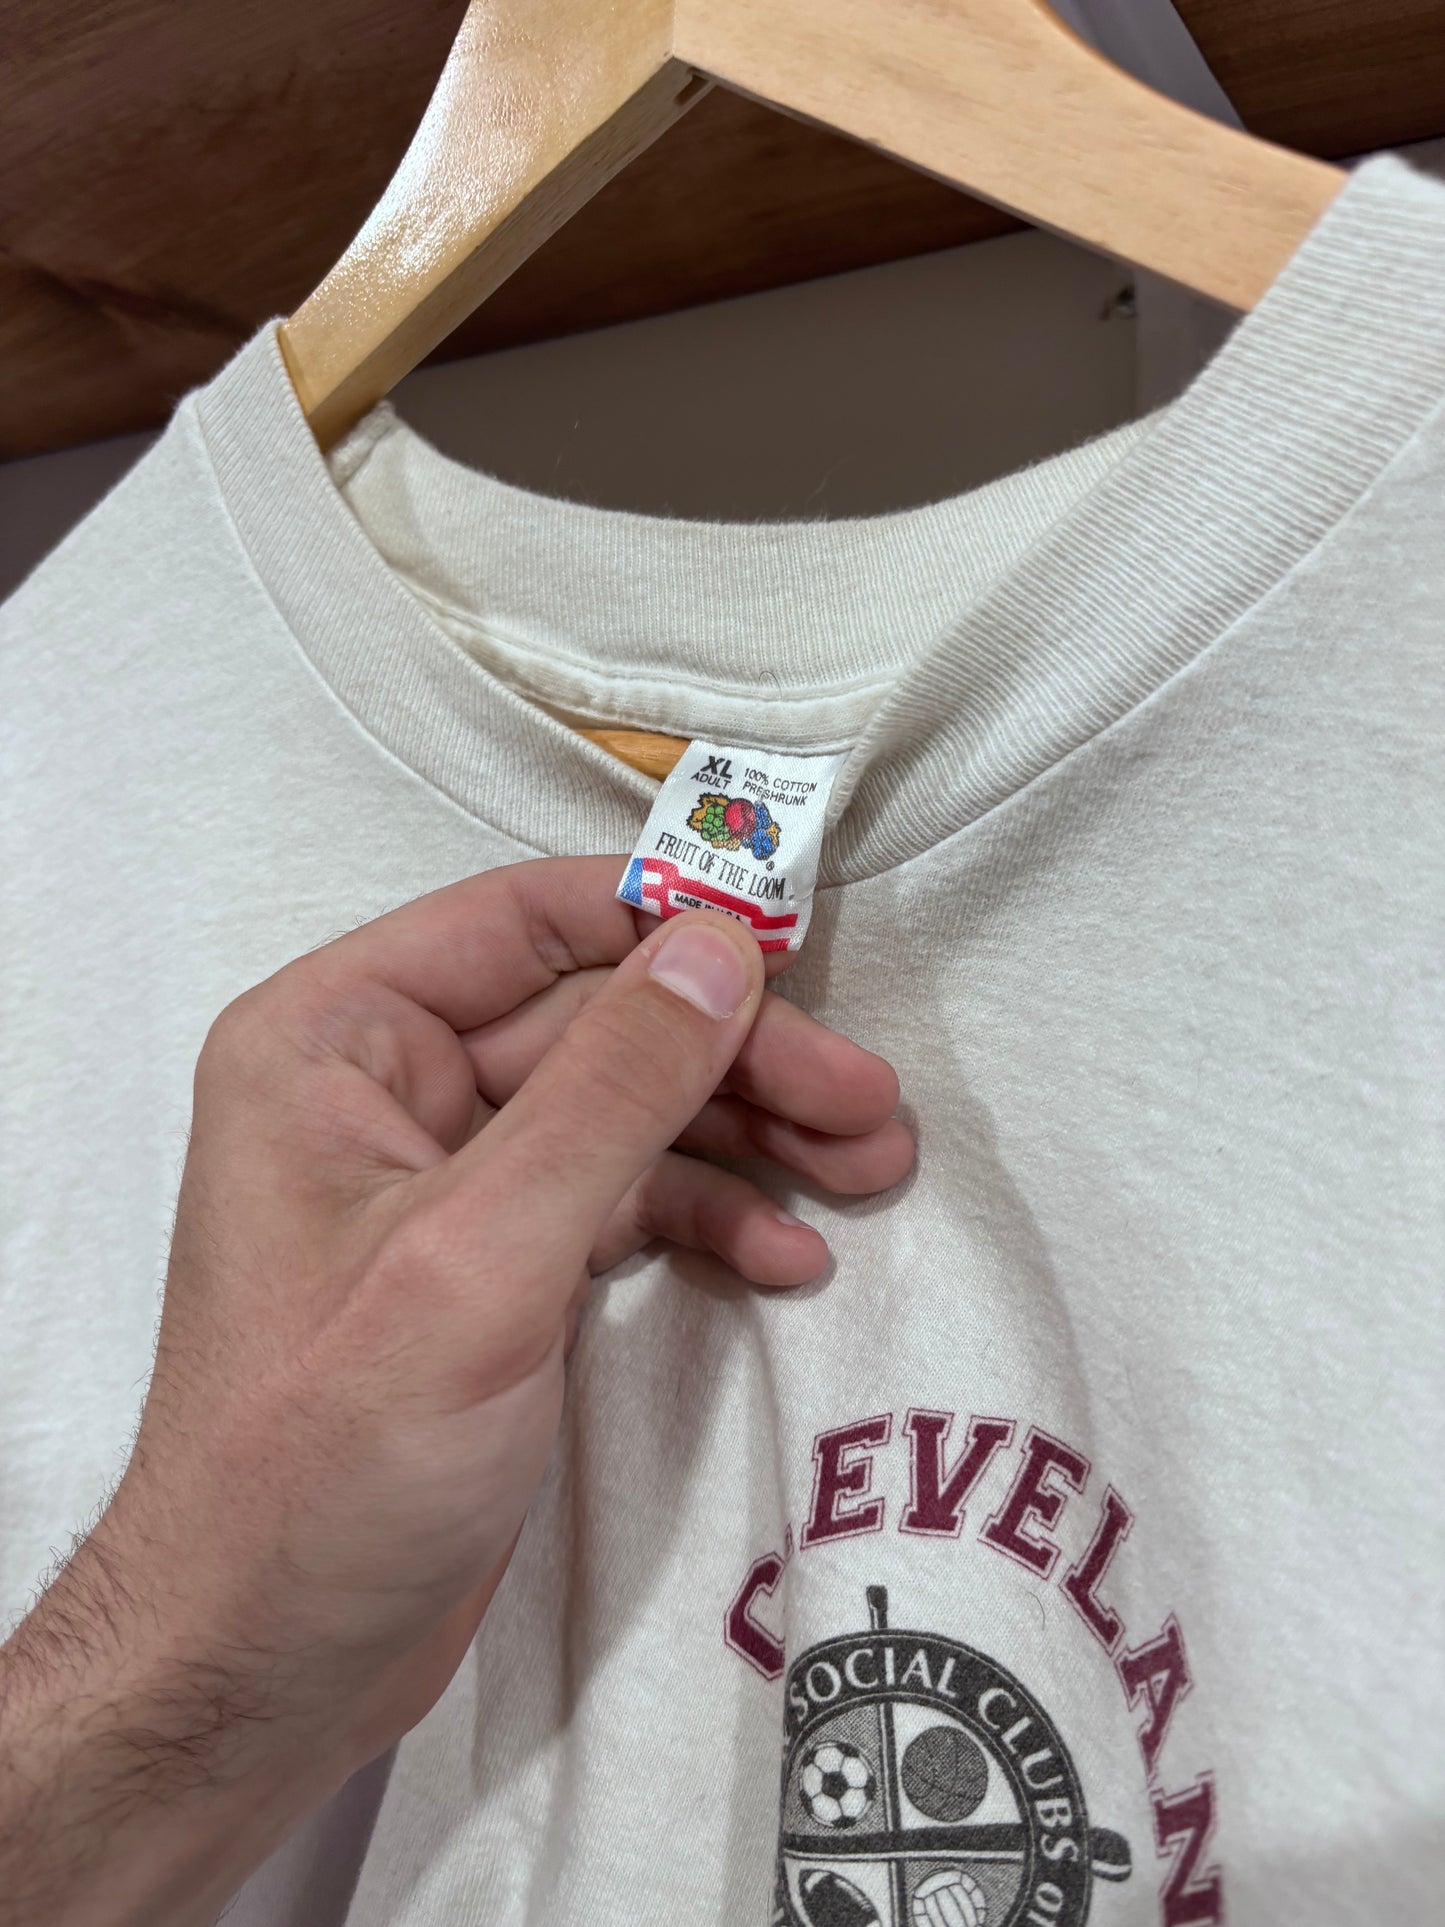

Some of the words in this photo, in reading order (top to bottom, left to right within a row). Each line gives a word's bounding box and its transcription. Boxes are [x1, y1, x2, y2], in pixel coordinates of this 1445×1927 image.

[700, 755, 733, 779] XL
[744, 767, 769, 786] 100%
[773, 778, 818, 793] COTTON
[690, 771, 732, 790] ADULT
[655, 832, 700, 865] FRUIT
[699, 850, 719, 873] OF
[718, 858, 749, 890] THE
[748, 873, 787, 900] LOOM
[675, 893, 702, 909] MADE
[724, 1408, 1223, 1927] CEVELAN
[789, 1647, 956, 1722] SOCIAL
[978, 1686, 1078, 1862] CLUBS
